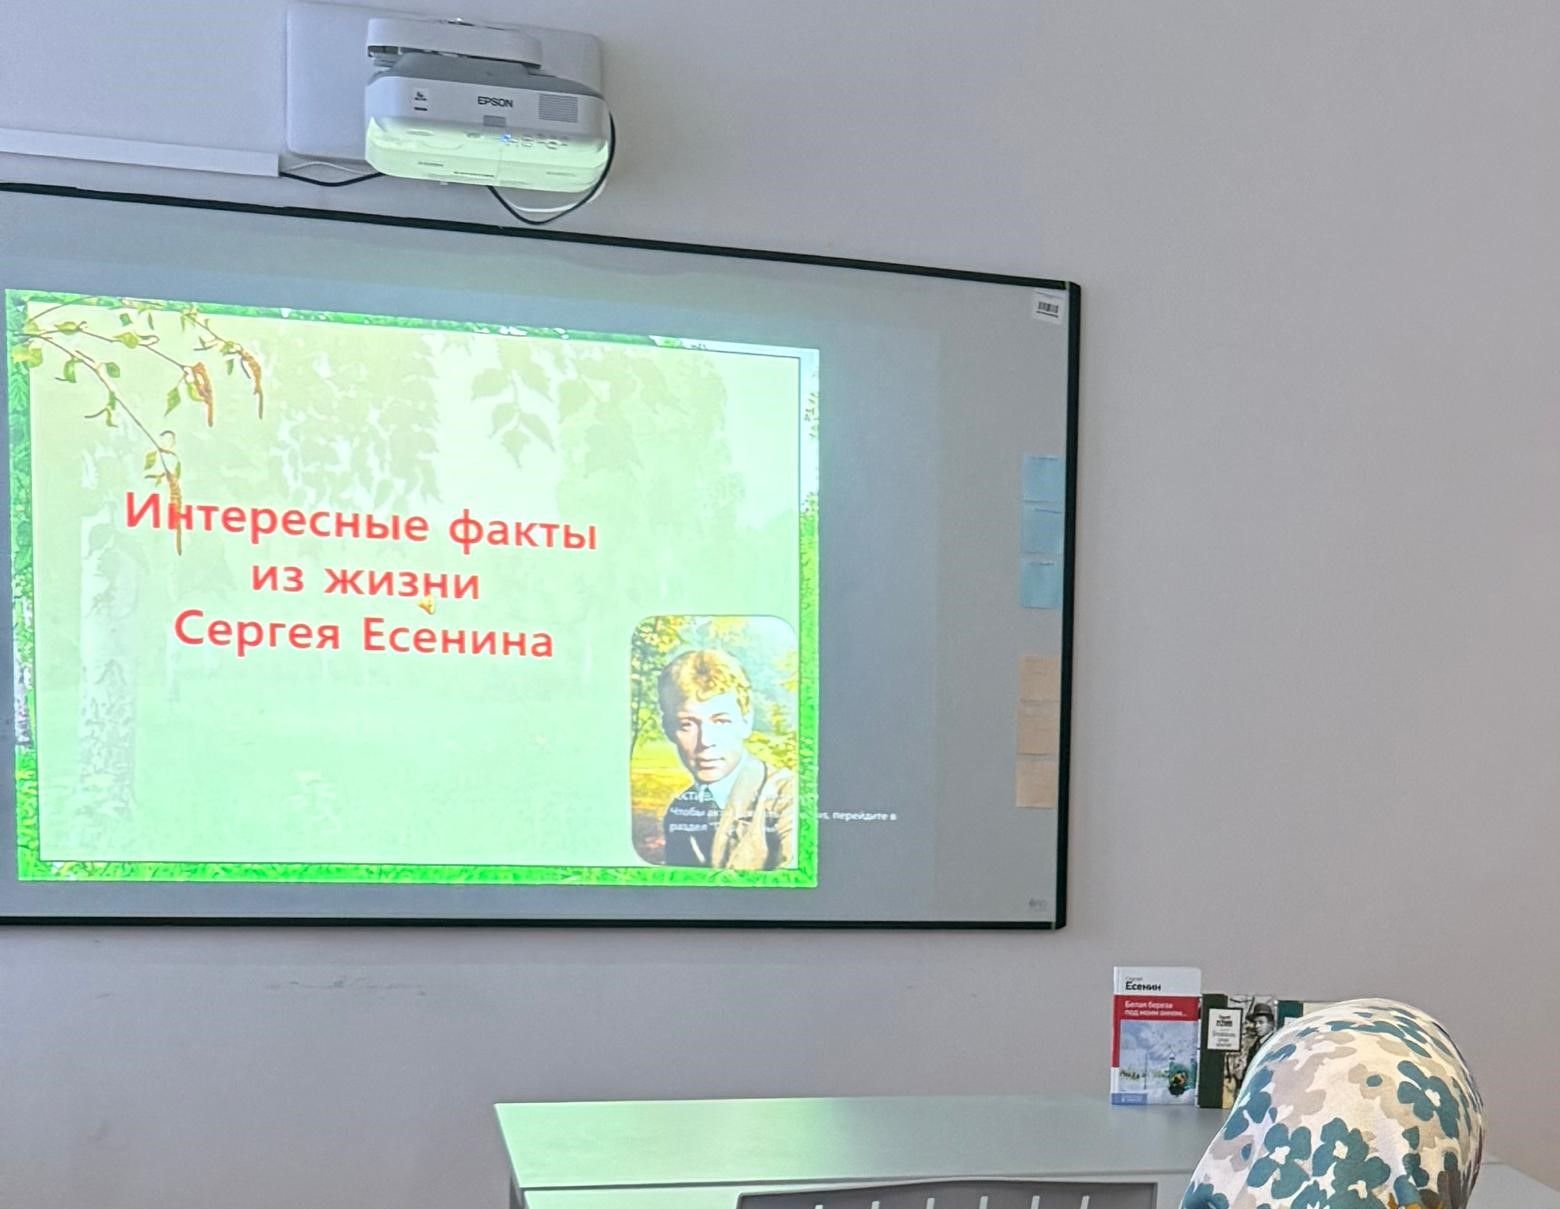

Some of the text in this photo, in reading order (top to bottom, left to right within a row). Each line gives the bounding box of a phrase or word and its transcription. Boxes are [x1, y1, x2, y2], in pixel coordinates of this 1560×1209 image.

[477, 96, 513, 108] EPSON
[126, 491, 597, 554] Интересные факты
[252, 566, 480, 599] из жизни
[174, 609, 554, 658] Сергея Есенина
[832, 811, 886, 821] перейдите
[1125, 981, 1162, 991] Есенин
